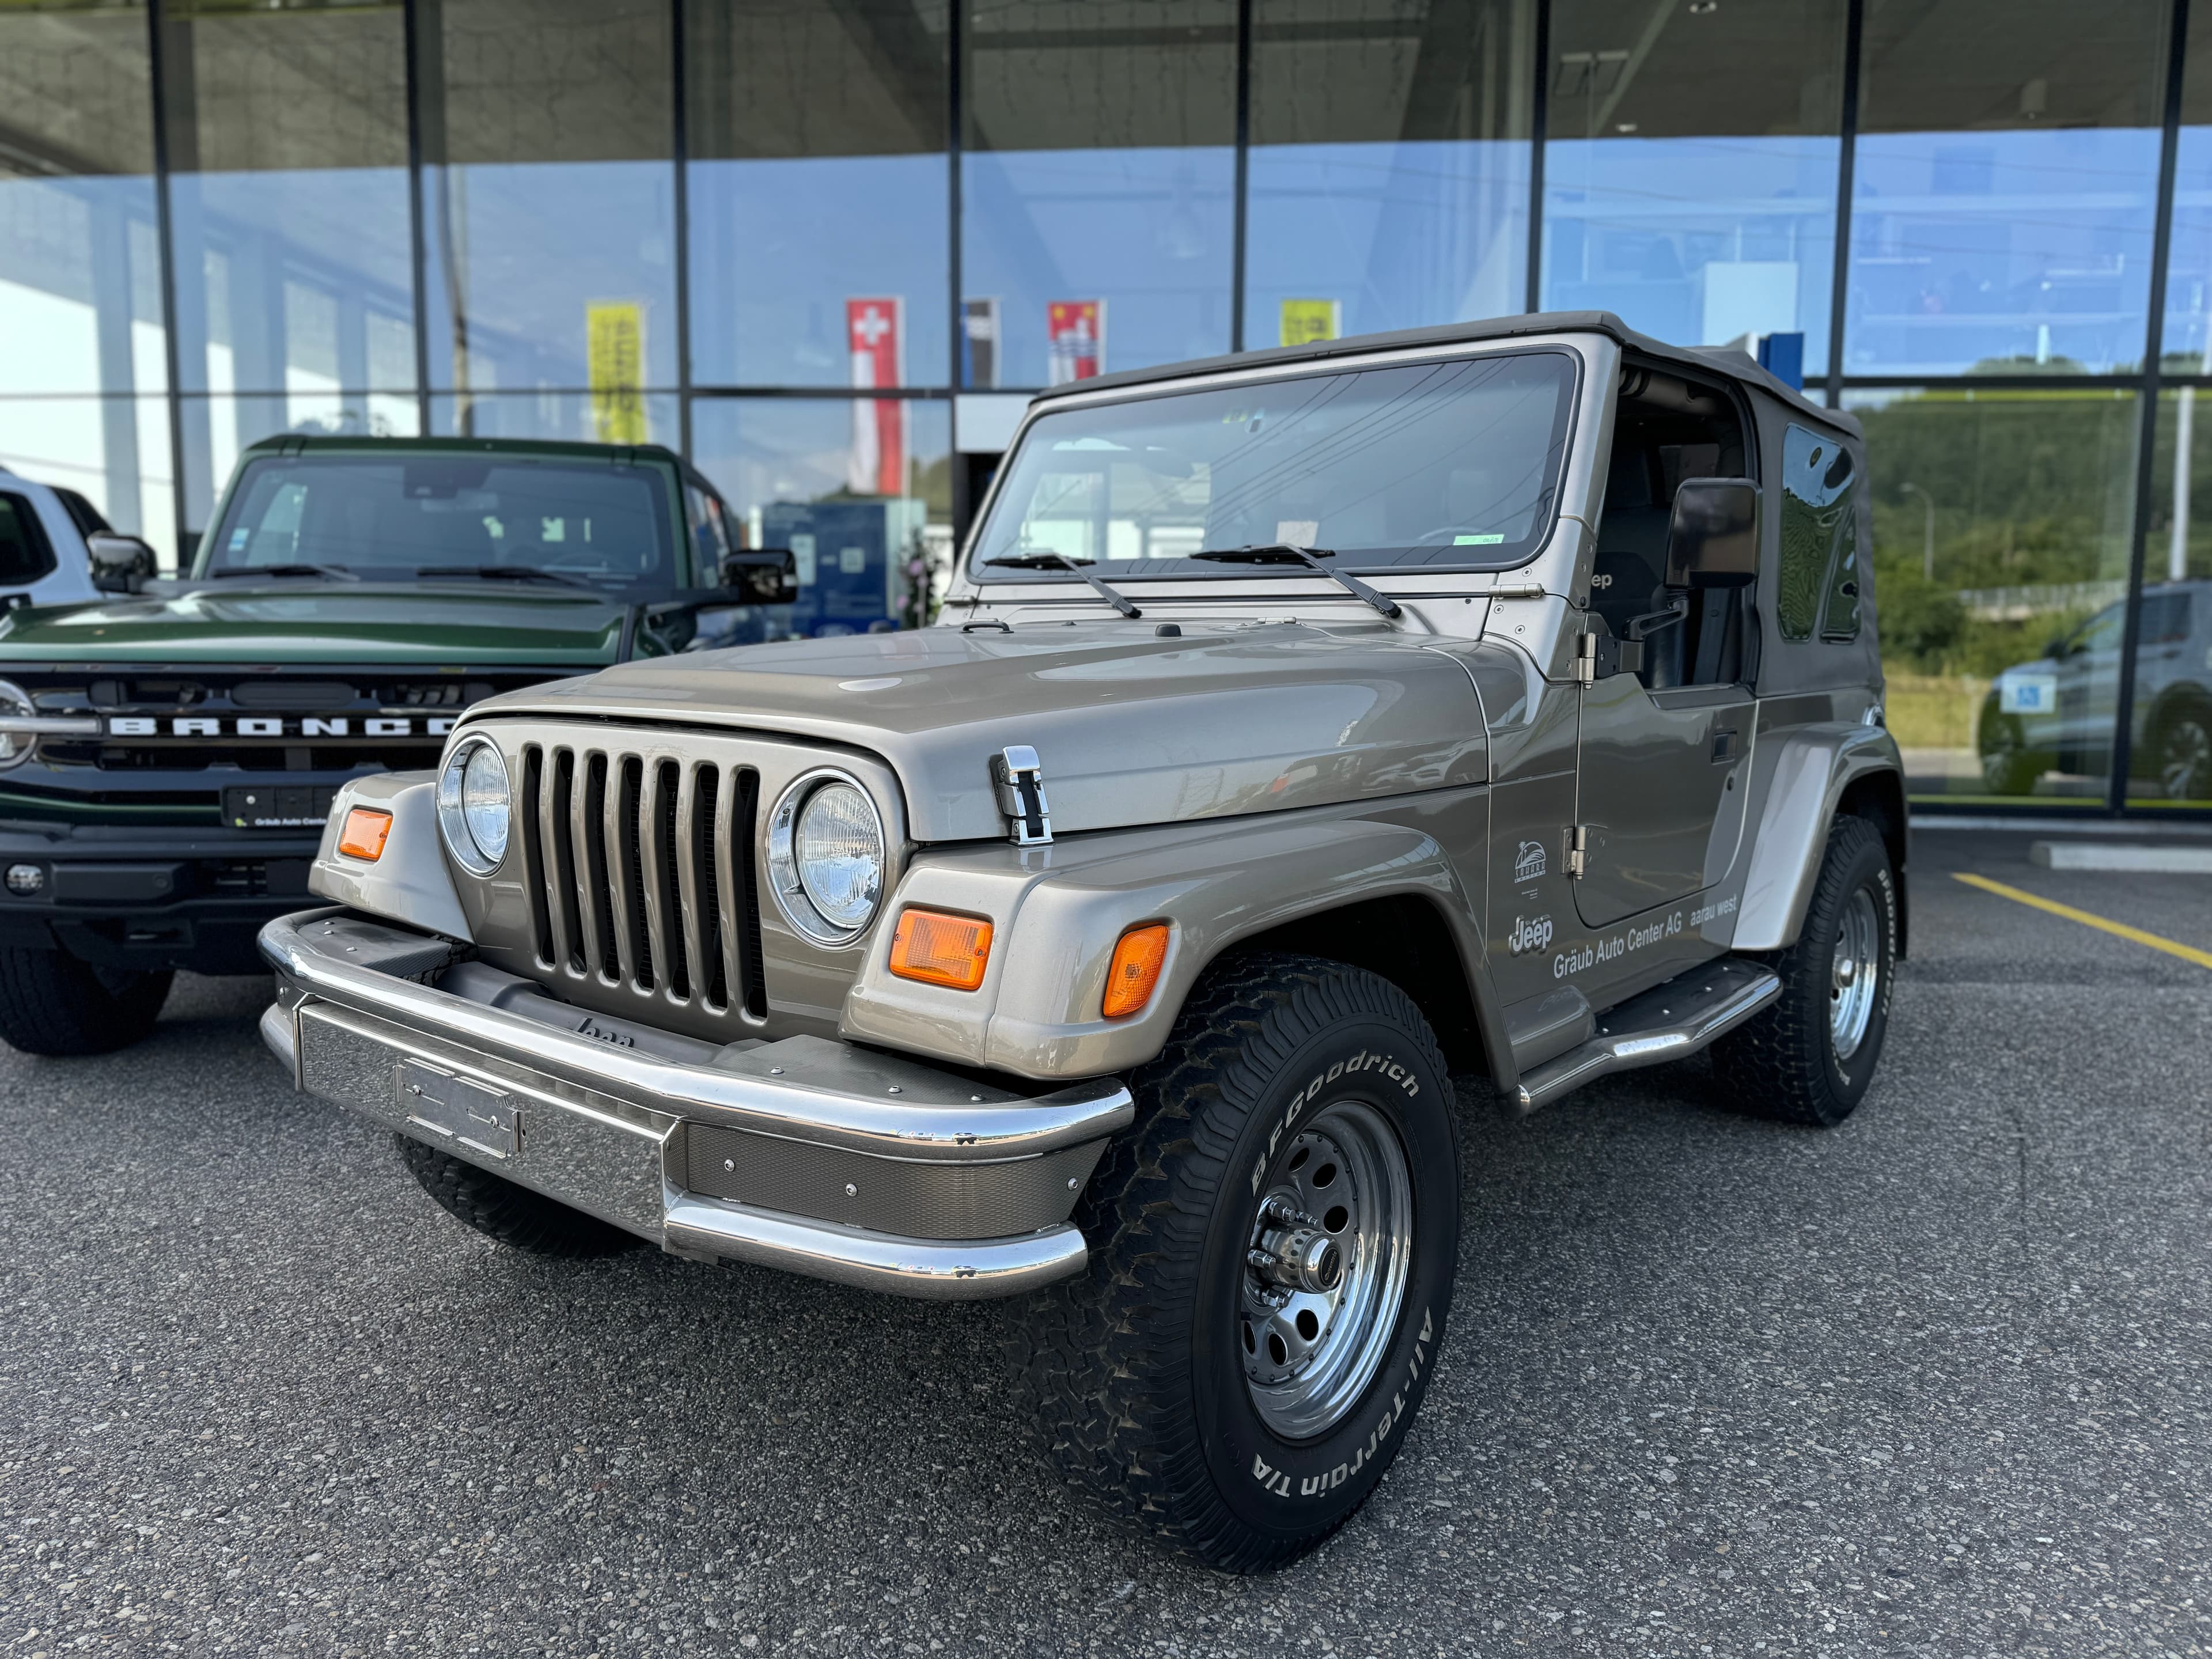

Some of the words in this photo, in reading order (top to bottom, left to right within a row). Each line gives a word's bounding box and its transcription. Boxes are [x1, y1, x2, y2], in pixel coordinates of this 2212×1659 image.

[1591, 574, 1612, 589] ep
[302, 817, 327, 825] Cente
[1516, 861, 1546, 878] SAHARA
[1510, 917, 1554, 954] Jeep
[1554, 944, 1593, 979] Gräub
[1596, 940, 1624, 964] Auto
[1627, 922, 1664, 951] Center
[1665, 911, 1682, 938] AG
[1690, 907, 1715, 927] aarau
[1717, 894, 1737, 915] west
[1250, 1050, 1420, 1198] BFGoodrich
[1300, 1305, 1434, 1498] All-Terrain
[1252, 1452, 1291, 1498] T/A
